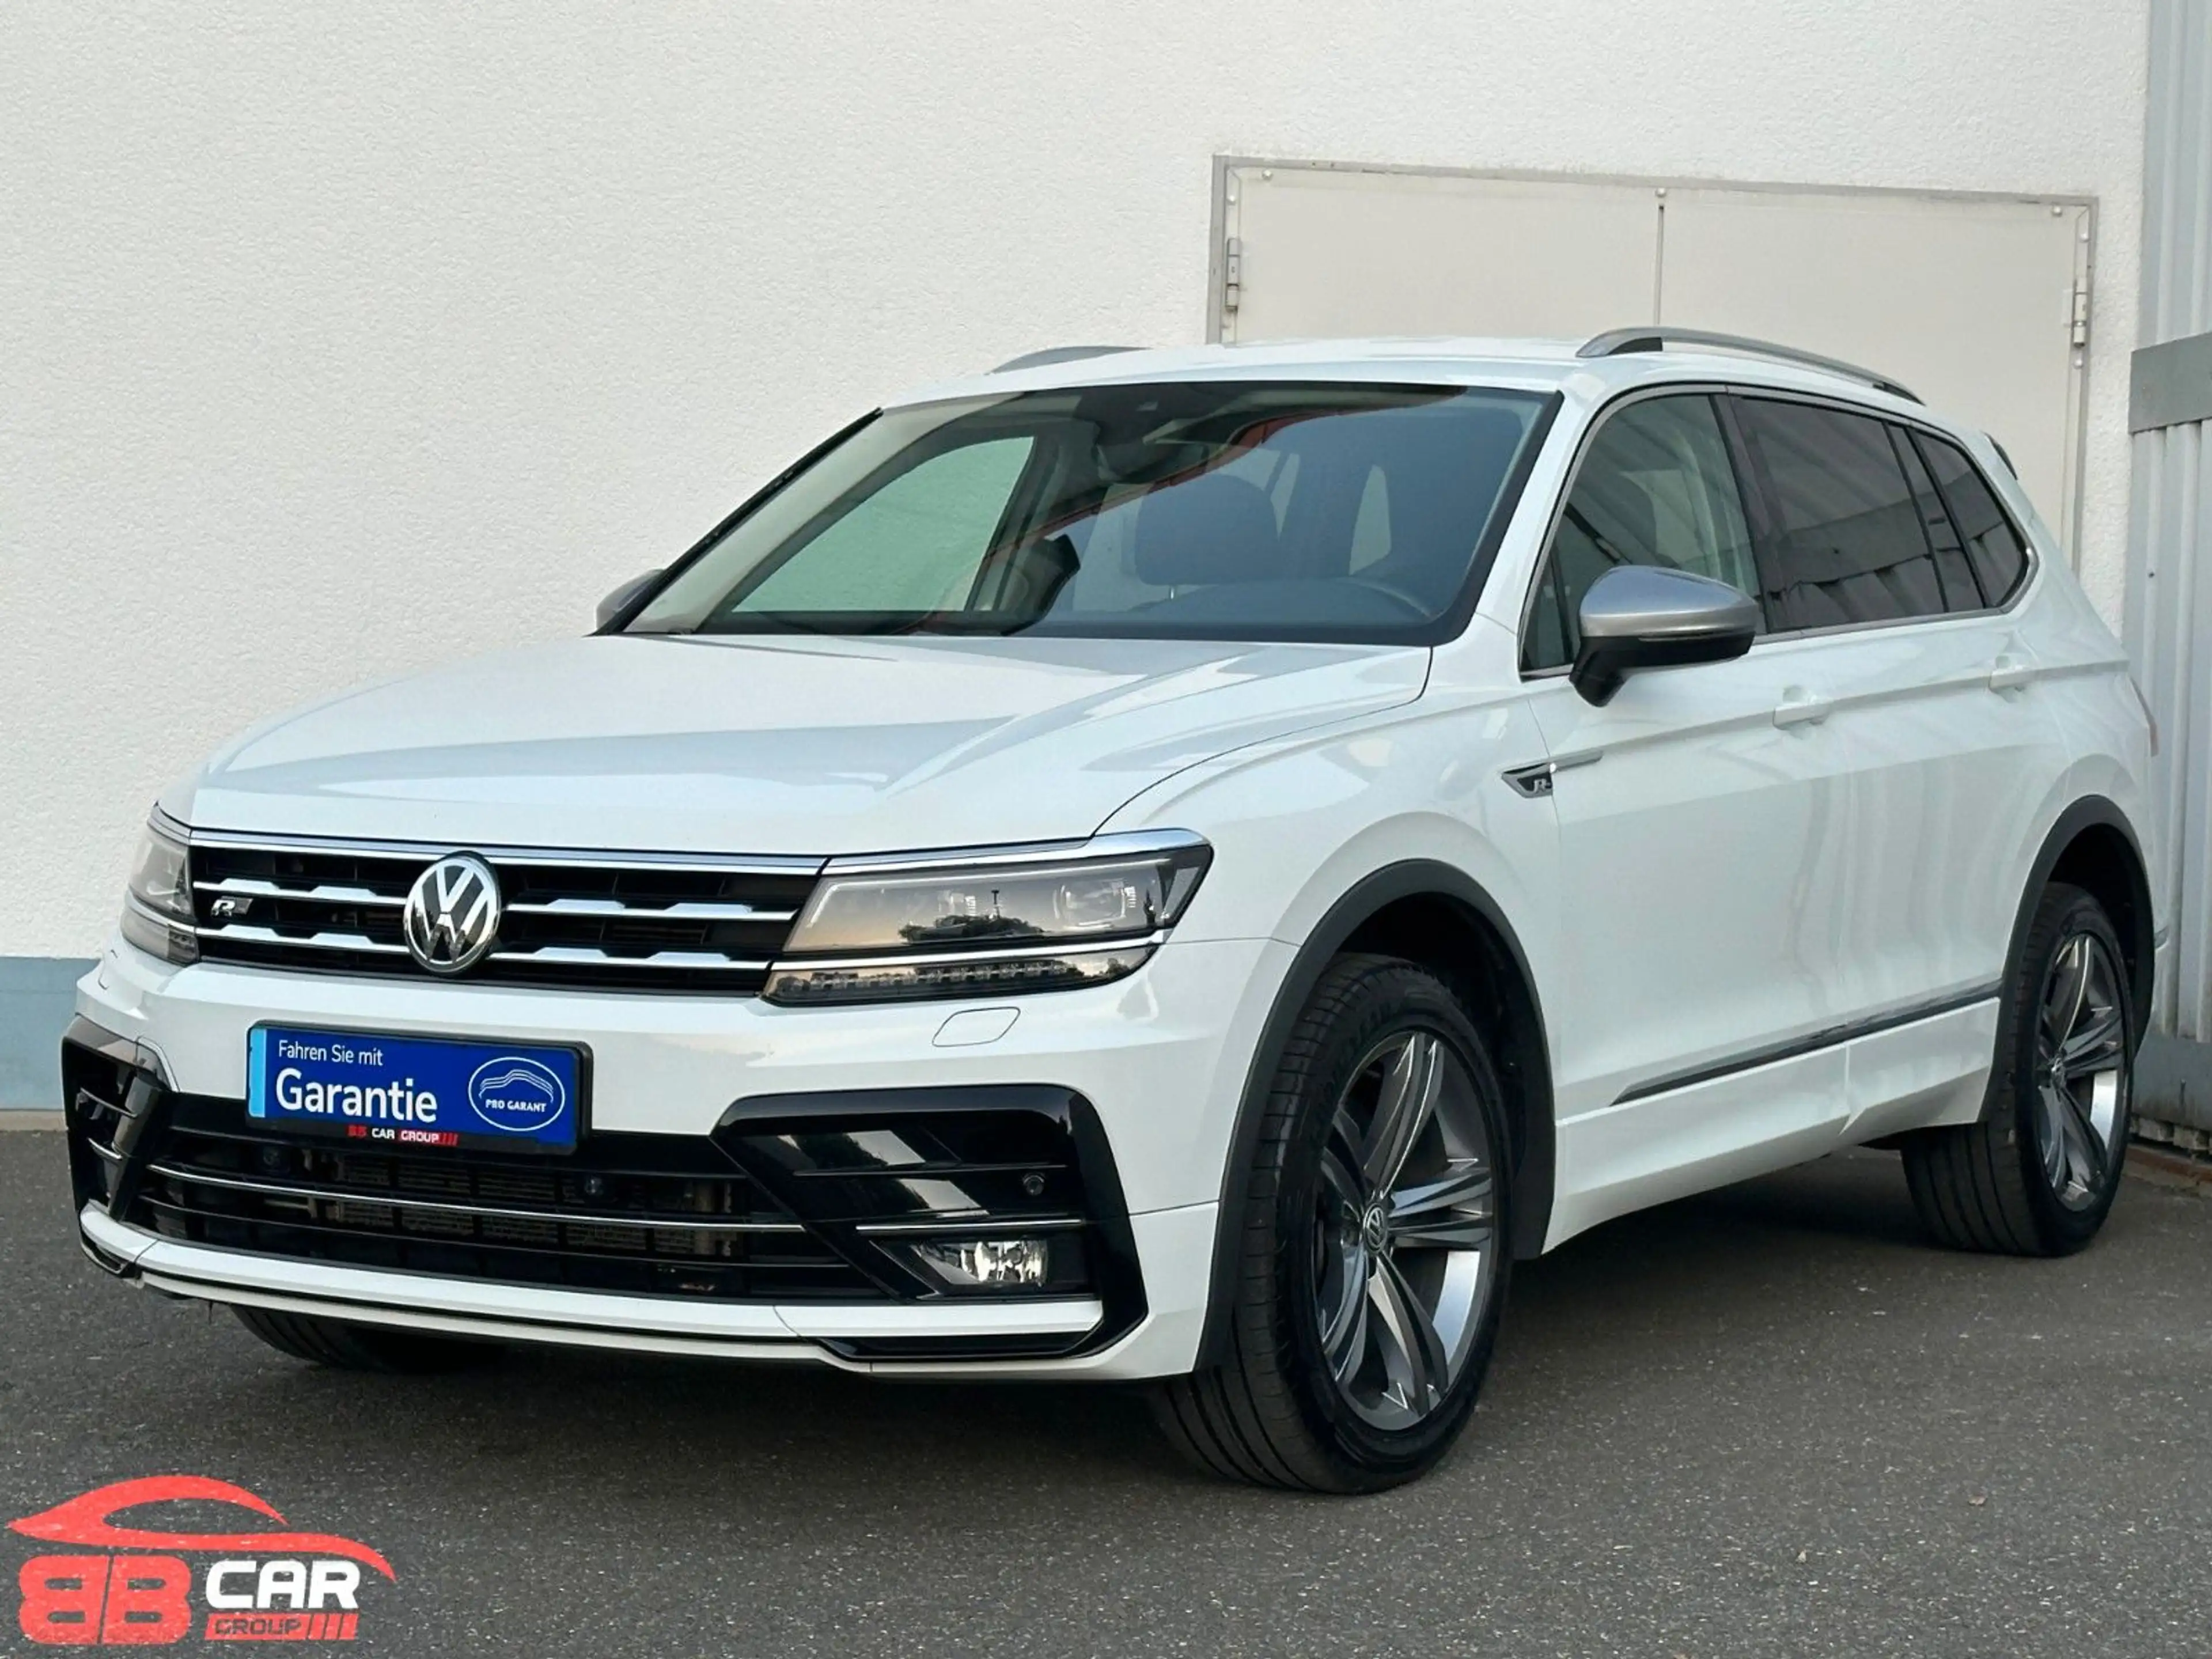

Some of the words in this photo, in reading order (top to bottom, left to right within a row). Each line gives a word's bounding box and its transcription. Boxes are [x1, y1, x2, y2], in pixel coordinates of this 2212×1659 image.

[210, 899, 236, 917] R
[407, 858, 498, 969] VW
[278, 1039, 327, 1061] Fahren
[331, 1044, 354, 1063] Sie
[358, 1047, 384, 1066] mit
[276, 1067, 438, 1123] Garantie
[485, 1099, 505, 1109] PRO
[507, 1100, 547, 1113] GARANT
[372, 1127, 395, 1140] CAR
[400, 1130, 440, 1143] GROUP
